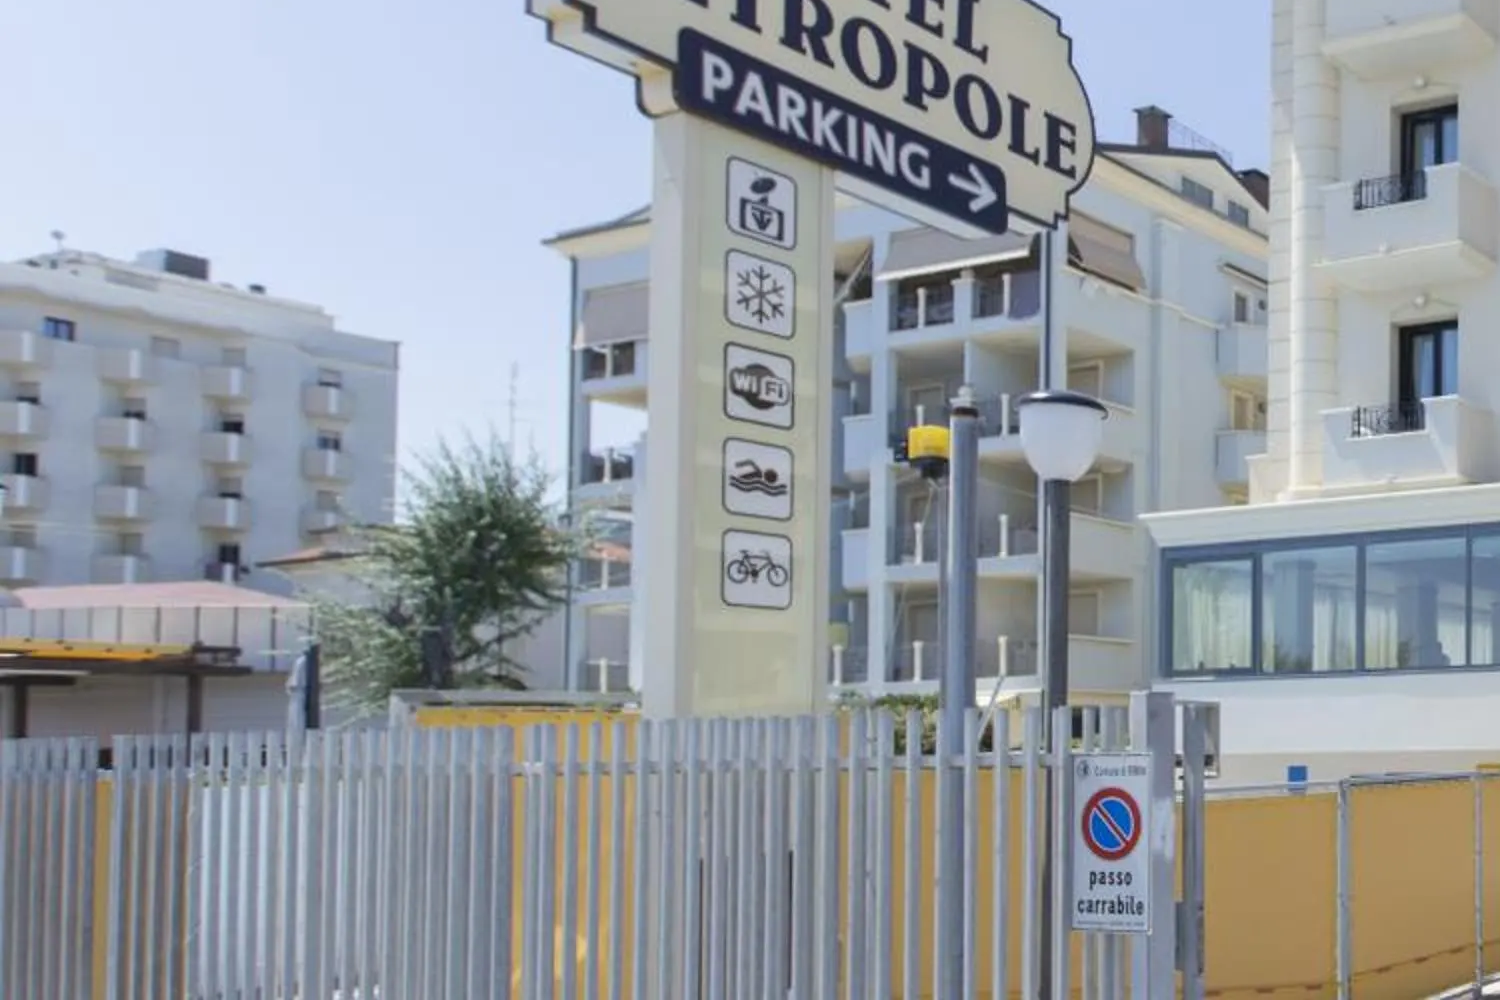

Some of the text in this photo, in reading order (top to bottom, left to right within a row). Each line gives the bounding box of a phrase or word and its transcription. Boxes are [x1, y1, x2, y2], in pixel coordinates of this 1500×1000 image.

[703, 50, 931, 190] PARKING
[1089, 870, 1133, 891] passo
[1077, 894, 1145, 917] carrabile
